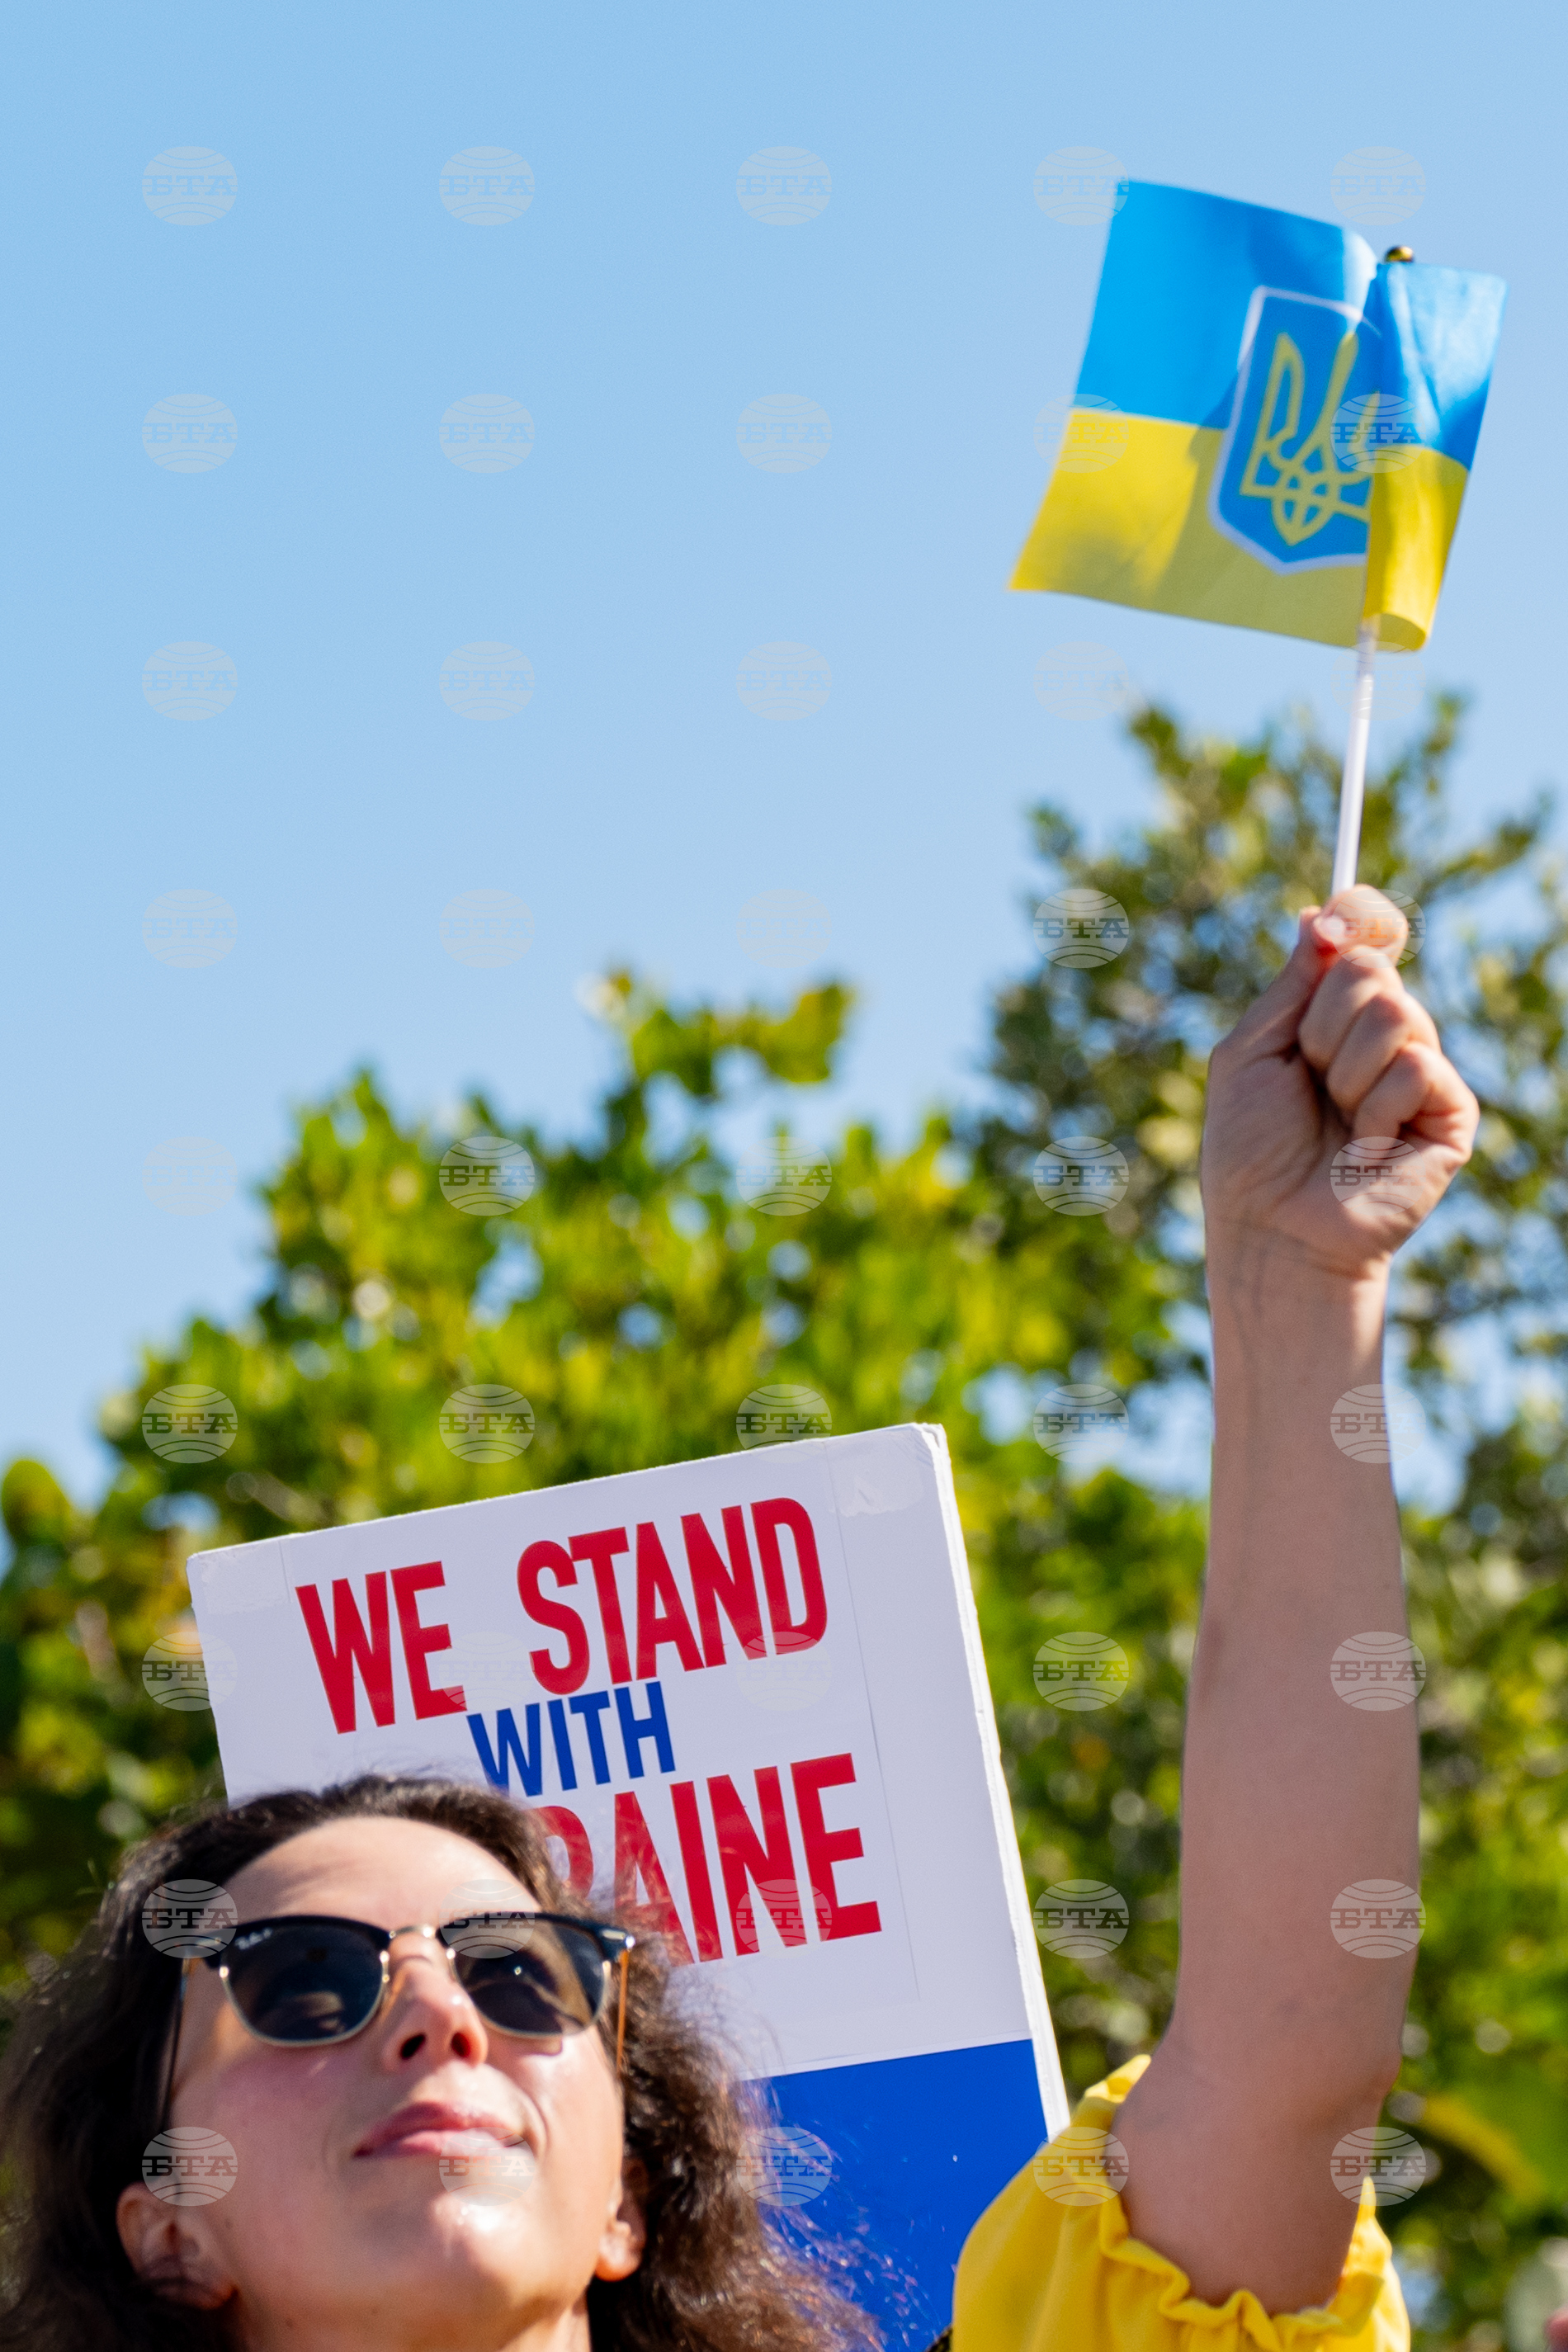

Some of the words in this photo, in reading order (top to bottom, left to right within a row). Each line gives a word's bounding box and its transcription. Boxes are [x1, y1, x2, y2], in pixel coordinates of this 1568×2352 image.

[295, 1560, 468, 1734] WE
[517, 1497, 828, 1695] STAND
[466, 1680, 676, 1797] WITH
